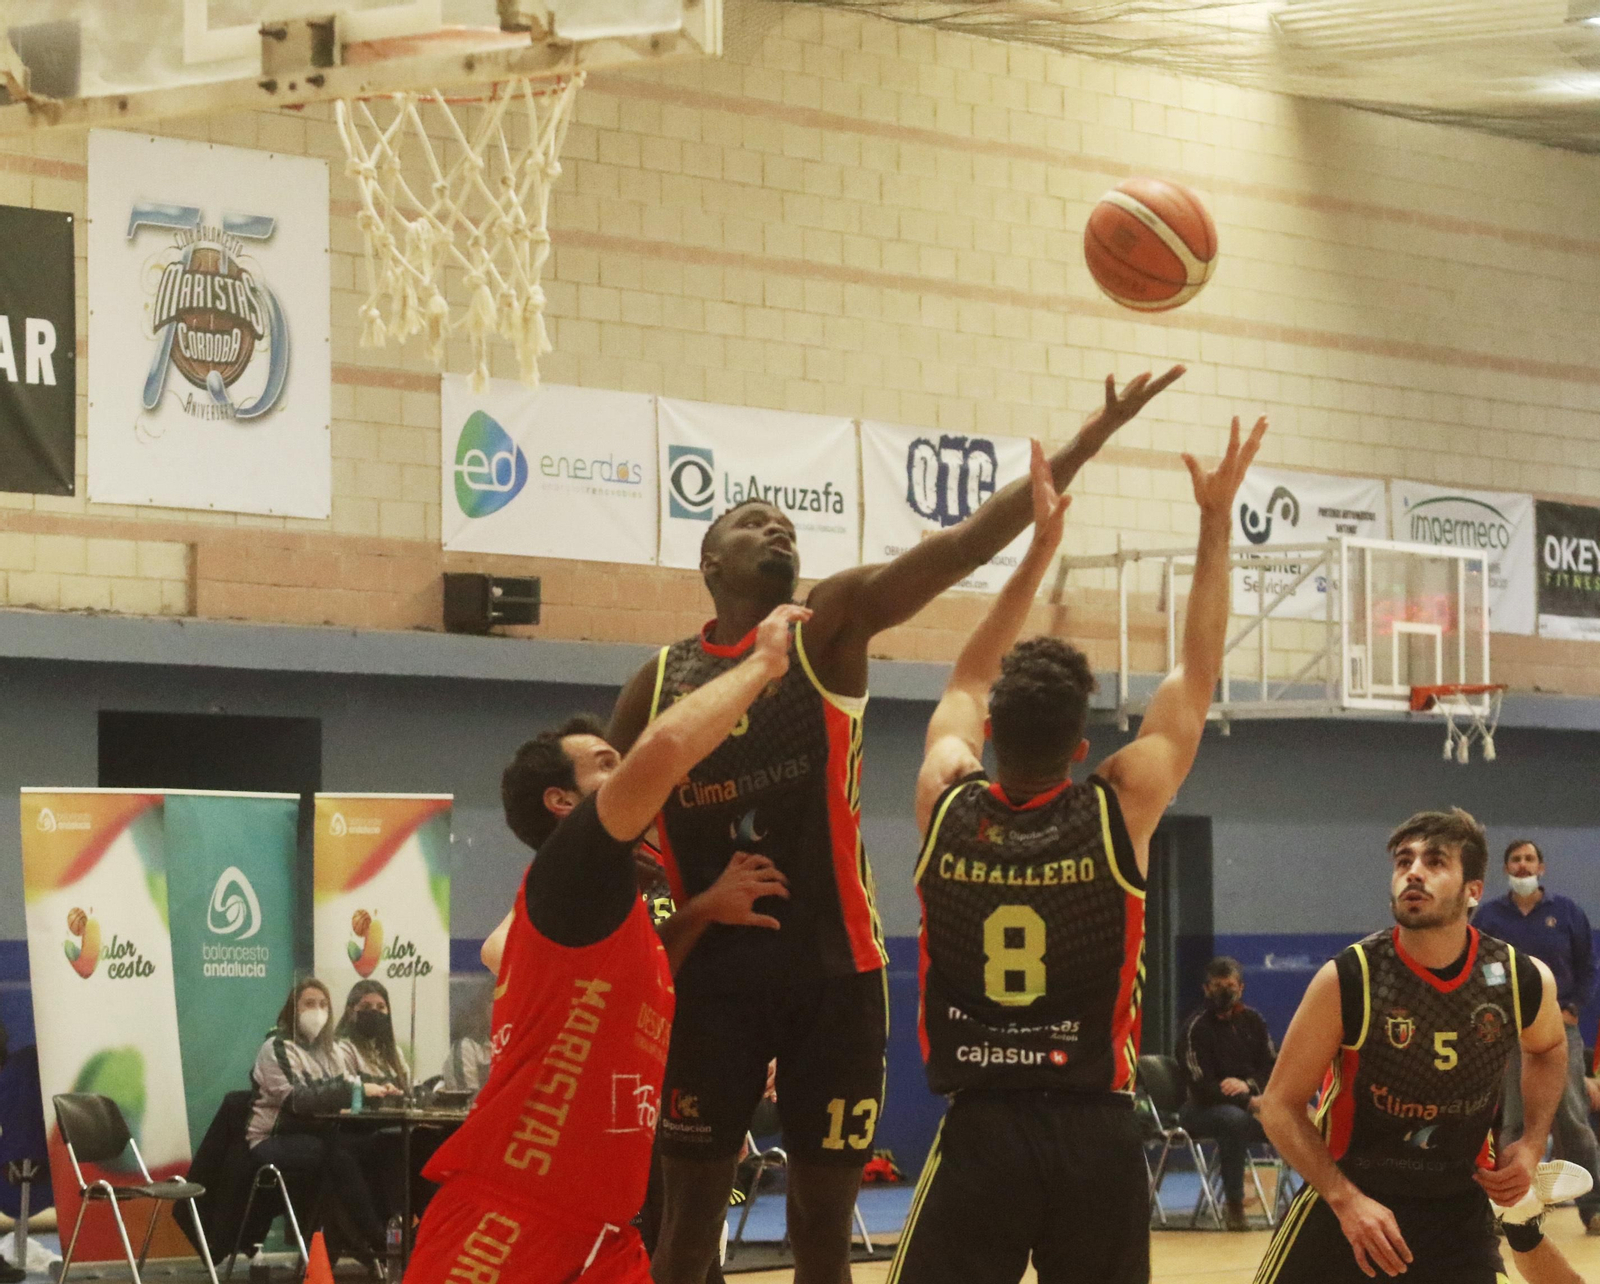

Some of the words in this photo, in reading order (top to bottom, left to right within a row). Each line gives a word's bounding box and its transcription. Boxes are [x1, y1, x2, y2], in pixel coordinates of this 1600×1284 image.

[154, 263, 264, 335] MARISTAS
[177, 322, 241, 363] CORDOBA
[724, 472, 844, 514] laArruzafa
[1410, 513, 1510, 550] impermeco
[678, 753, 810, 808] Climanavas
[939, 853, 1096, 886] CABALLERO
[107, 955, 156, 980] cesto
[203, 942, 269, 961] baloncesto
[387, 955, 433, 979] cesto
[983, 905, 1047, 1006] 8
[956, 1041, 1047, 1067] cajasur
[1433, 1031, 1458, 1071] 5
[503, 977, 612, 1177] MARISTAS
[821, 1097, 878, 1150] 13
[444, 1211, 521, 1284] COR
